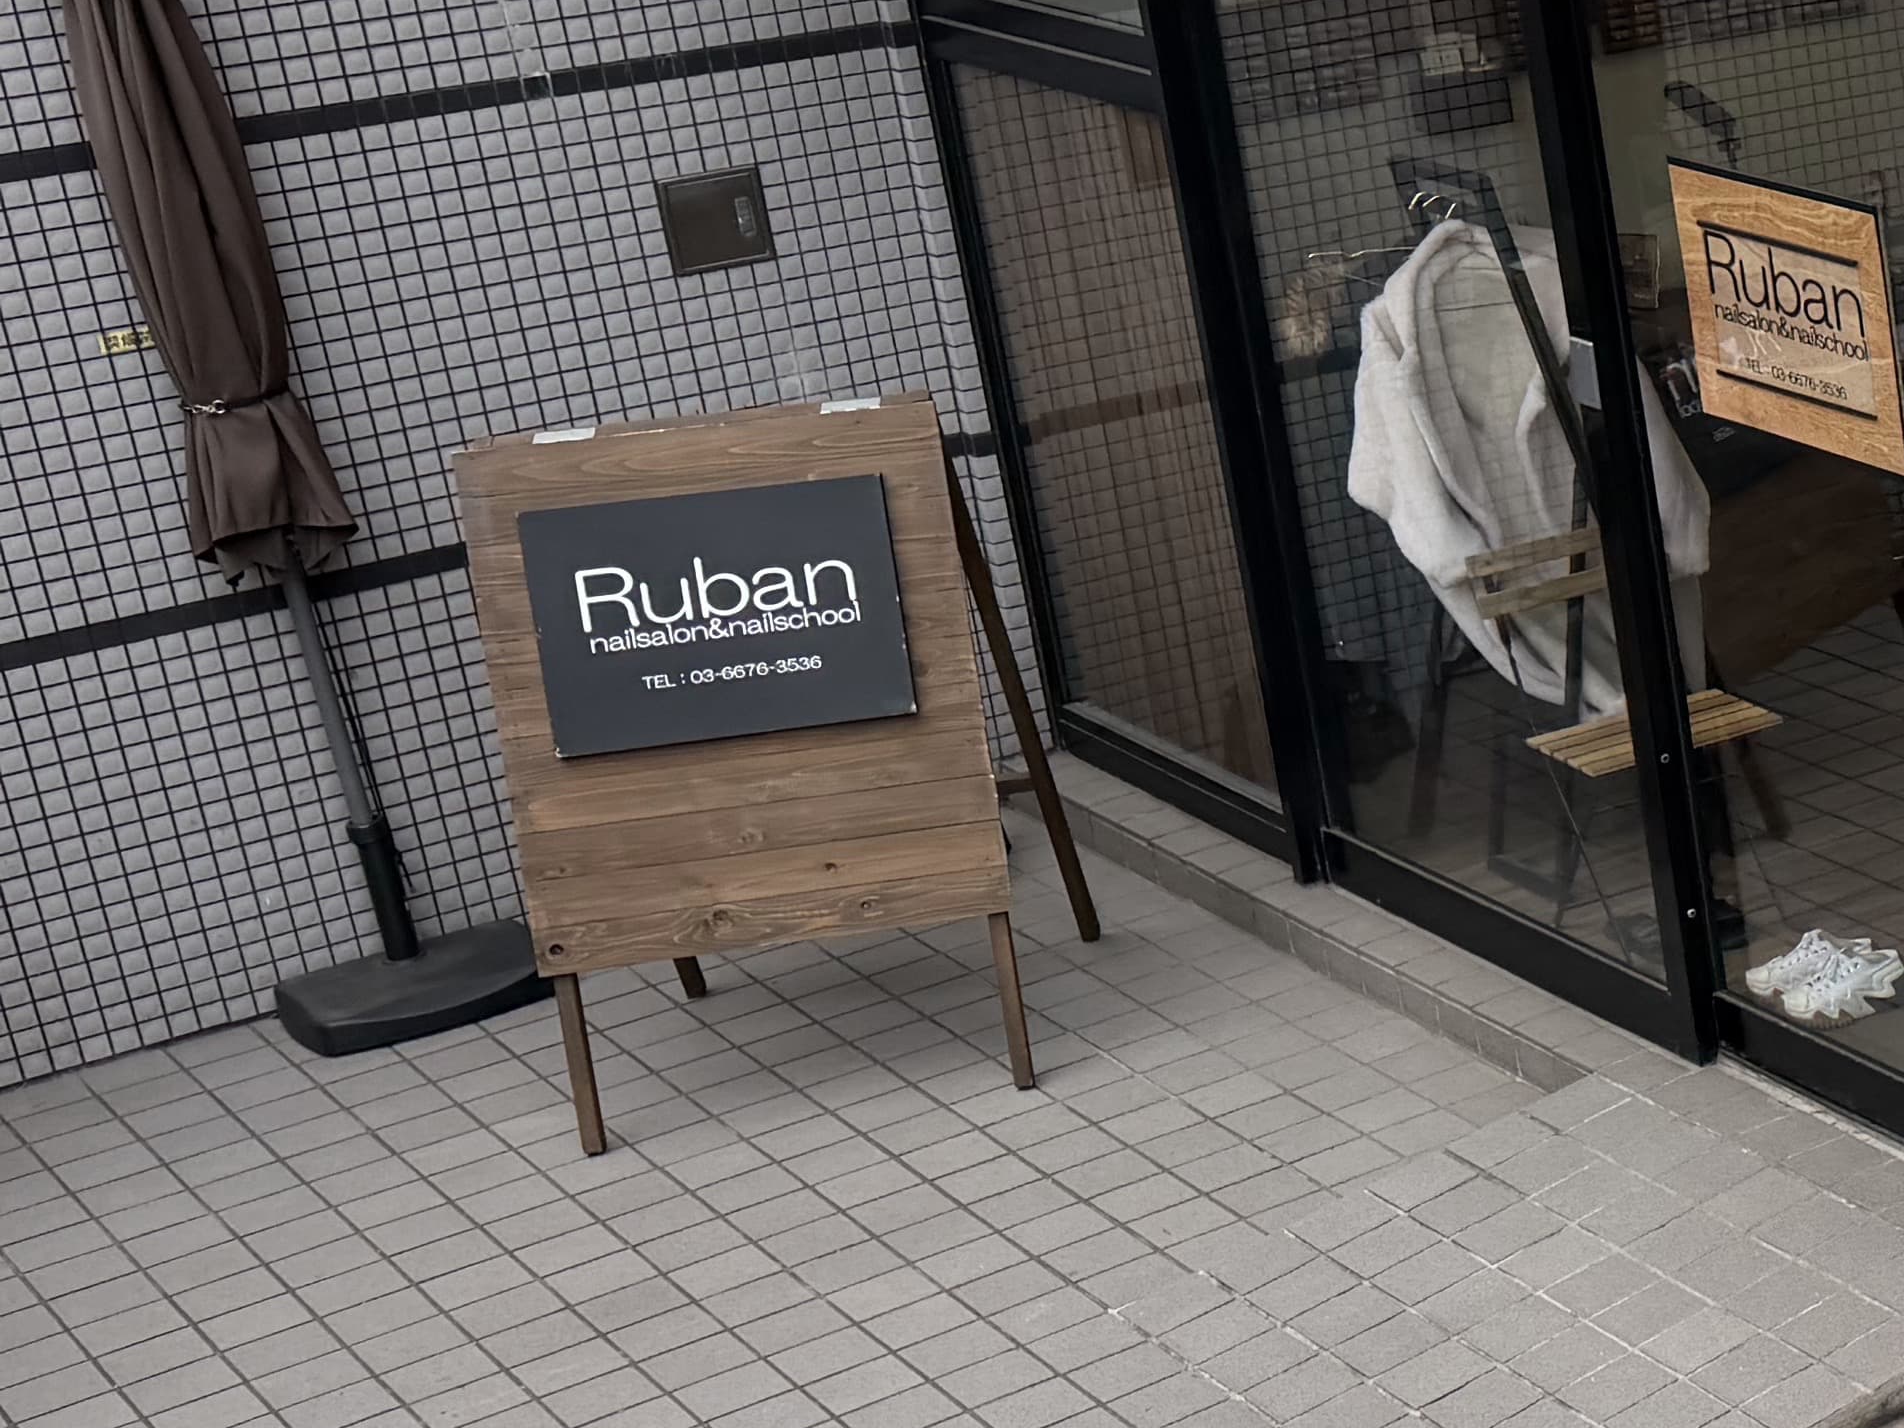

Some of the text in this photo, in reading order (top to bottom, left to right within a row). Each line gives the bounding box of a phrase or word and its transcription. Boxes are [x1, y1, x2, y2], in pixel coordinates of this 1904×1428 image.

[1703, 229, 1865, 338] Ruban
[1715, 303, 1870, 362] nailsalon&nailschool
[574, 556, 857, 633] Ruban
[589, 600, 861, 654] nailsalon&nailschool
[690, 655, 823, 685] 03-6676-3536
